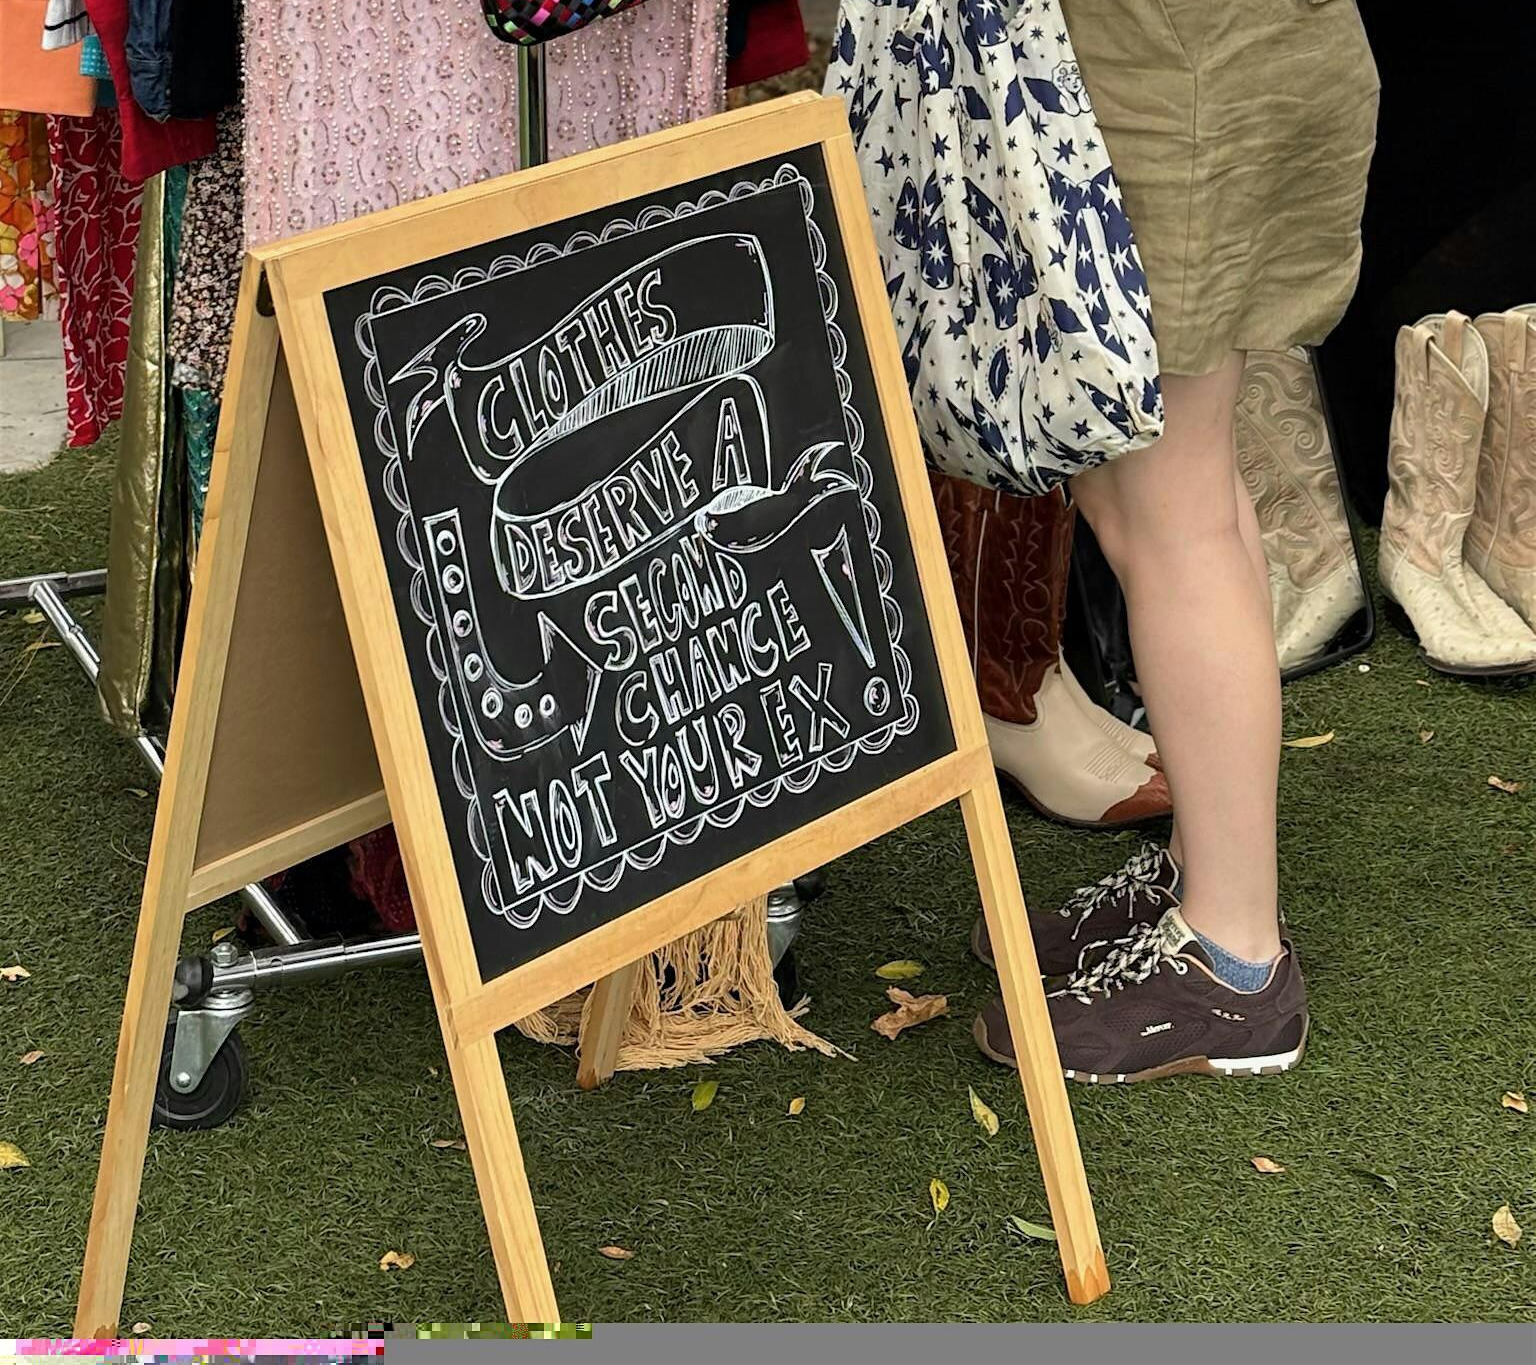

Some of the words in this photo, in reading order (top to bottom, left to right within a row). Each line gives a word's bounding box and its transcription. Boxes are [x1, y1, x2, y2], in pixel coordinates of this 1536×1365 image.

[477, 268, 677, 460] CLOTHES
[504, 430, 700, 593] DESERVE
[712, 398, 752, 492] A
[584, 534, 747, 671] SECOND
[615, 580, 811, 746] CHANCE
[493, 751, 618, 895] NOT
[620, 703, 763, 829] YOUR
[760, 663, 850, 768] EX
